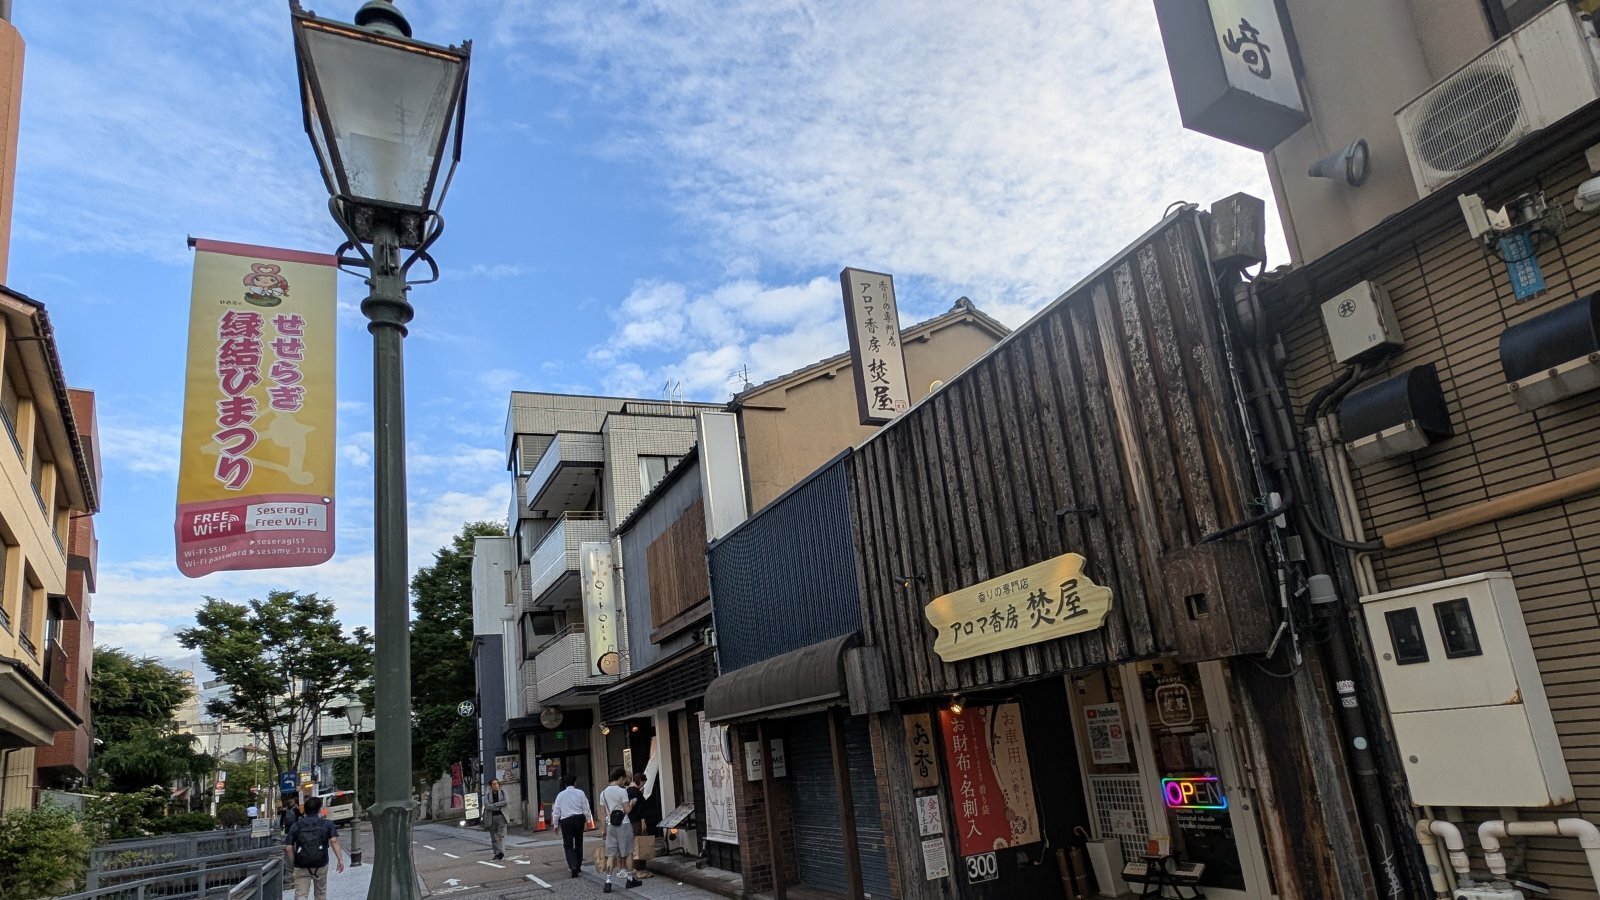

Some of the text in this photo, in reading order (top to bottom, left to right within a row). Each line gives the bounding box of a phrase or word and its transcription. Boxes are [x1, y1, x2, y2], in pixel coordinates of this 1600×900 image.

[878, 280, 897, 348] 香りの専門店
[268, 314, 306, 411] せせらぎ
[213, 310, 264, 490] 縁結びまつり
[193, 511, 230, 525] FREE
[255, 517, 317, 527] Free Wi-Fi
[256, 506, 309, 516] Seseragi
[193, 521, 232, 536] Wi-Fi
[184, 547, 207, 558] Wi-Fi
[208, 545, 227, 554] SSID
[184, 557, 207, 568] Wi-Fi
[208, 549, 247, 564] password
[977, 578, 1029, 603] 香りの専門店
[913, 723, 933, 778] お香
[1165, 781, 1222, 804] OPEN
[927, 797, 941, 832] 金沢の
[967, 853, 997, 879] 300
